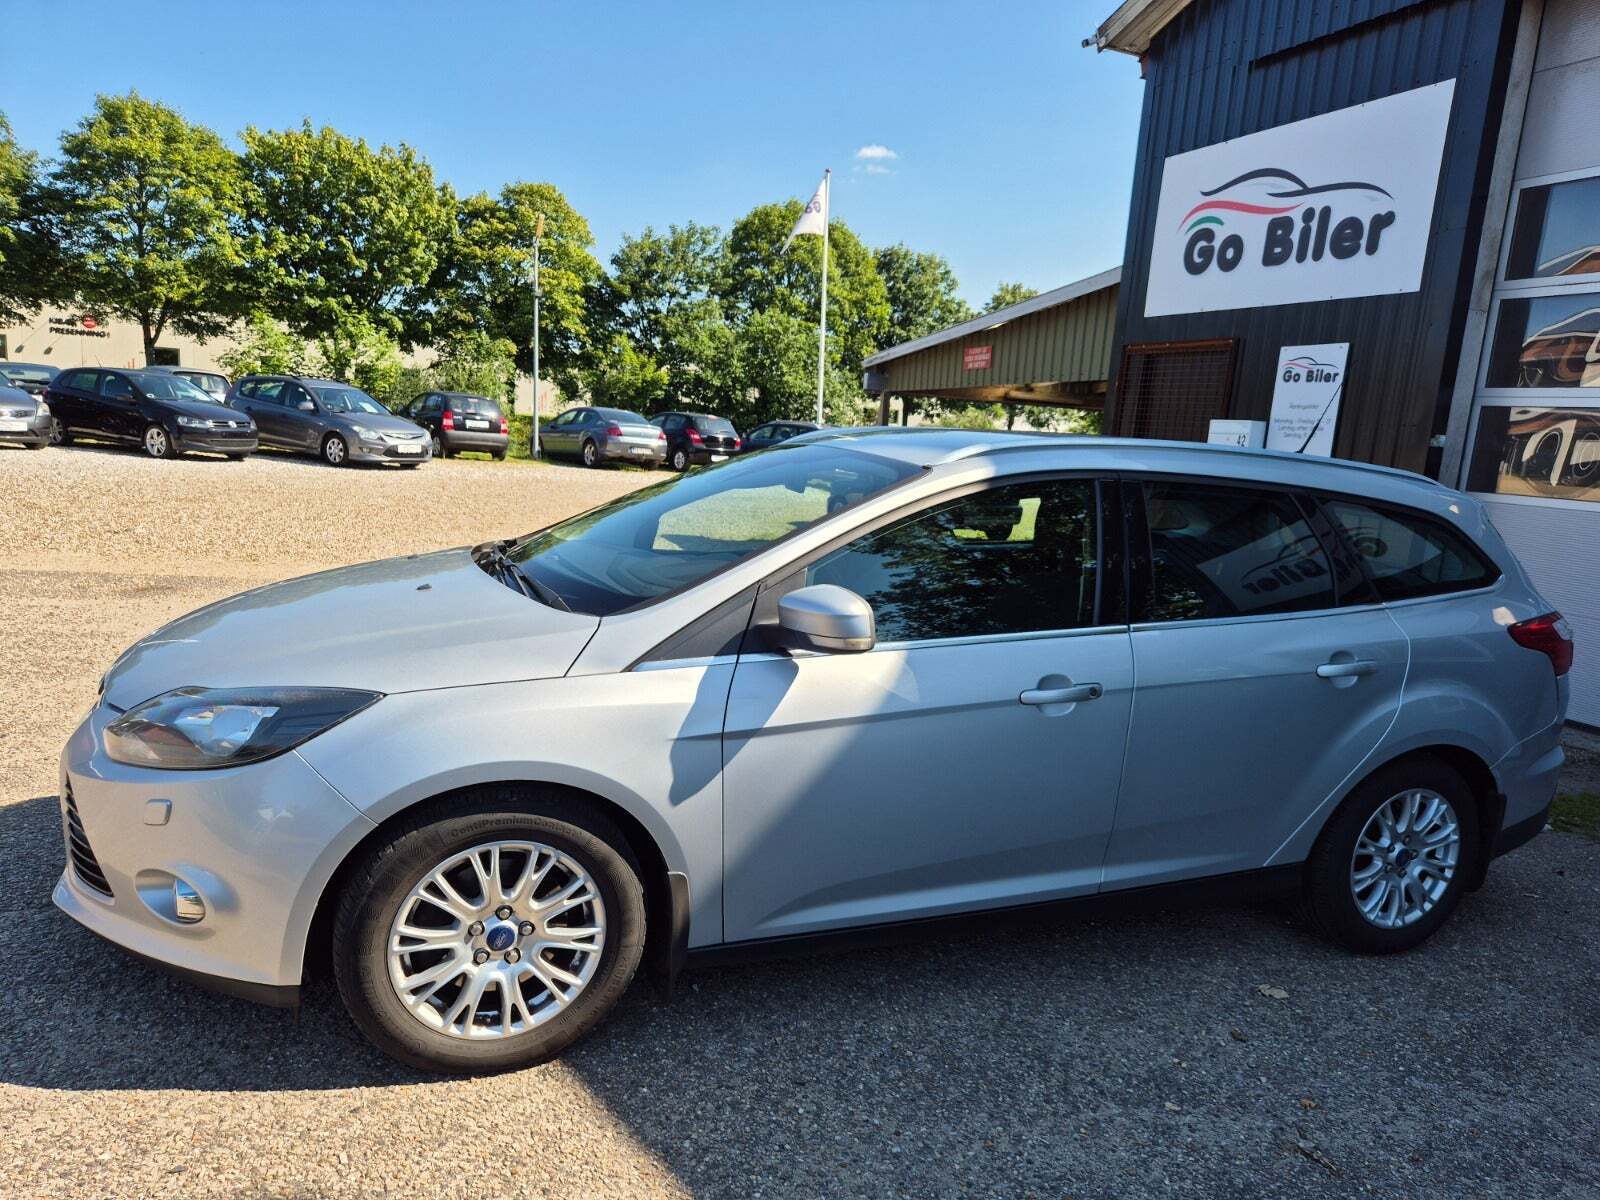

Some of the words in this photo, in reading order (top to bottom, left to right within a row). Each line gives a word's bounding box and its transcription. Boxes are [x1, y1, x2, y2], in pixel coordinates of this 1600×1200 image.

[1183, 227, 1244, 276] Go
[1261, 205, 1396, 267] Biler
[1282, 369, 1301, 384] Go
[1305, 368, 1340, 384] Biler
